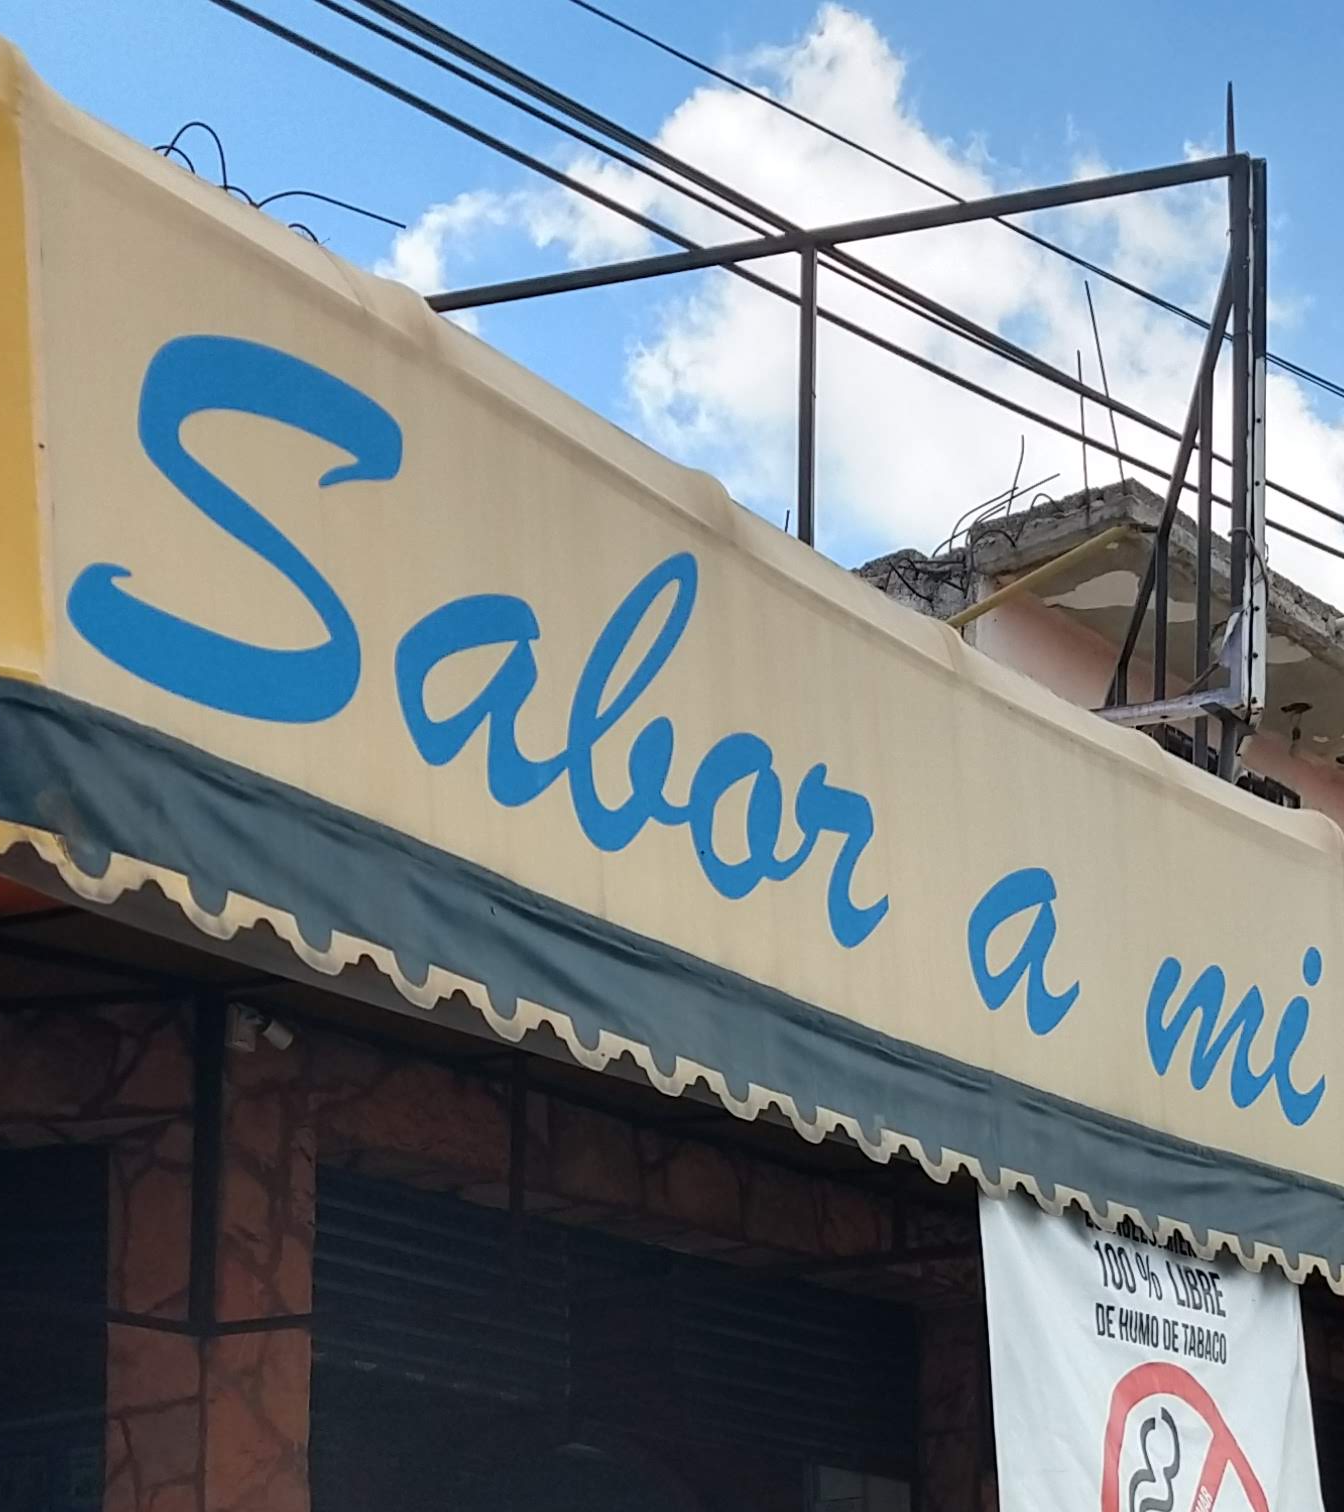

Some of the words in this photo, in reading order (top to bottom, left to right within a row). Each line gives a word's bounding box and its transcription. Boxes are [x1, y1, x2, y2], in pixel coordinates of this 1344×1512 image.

[66, 334, 889, 949] Sabor
[968, 866, 1080, 1036] a
[1146, 946, 1325, 1128] mi
[1166, 1260, 1227, 1318] LIBRE
[1095, 1302, 1116, 1339] DE
[1119, 1307, 1160, 1349] HUMO
[1163, 1318, 1180, 1354] DE
[1181, 1323, 1228, 1365] TABACO
